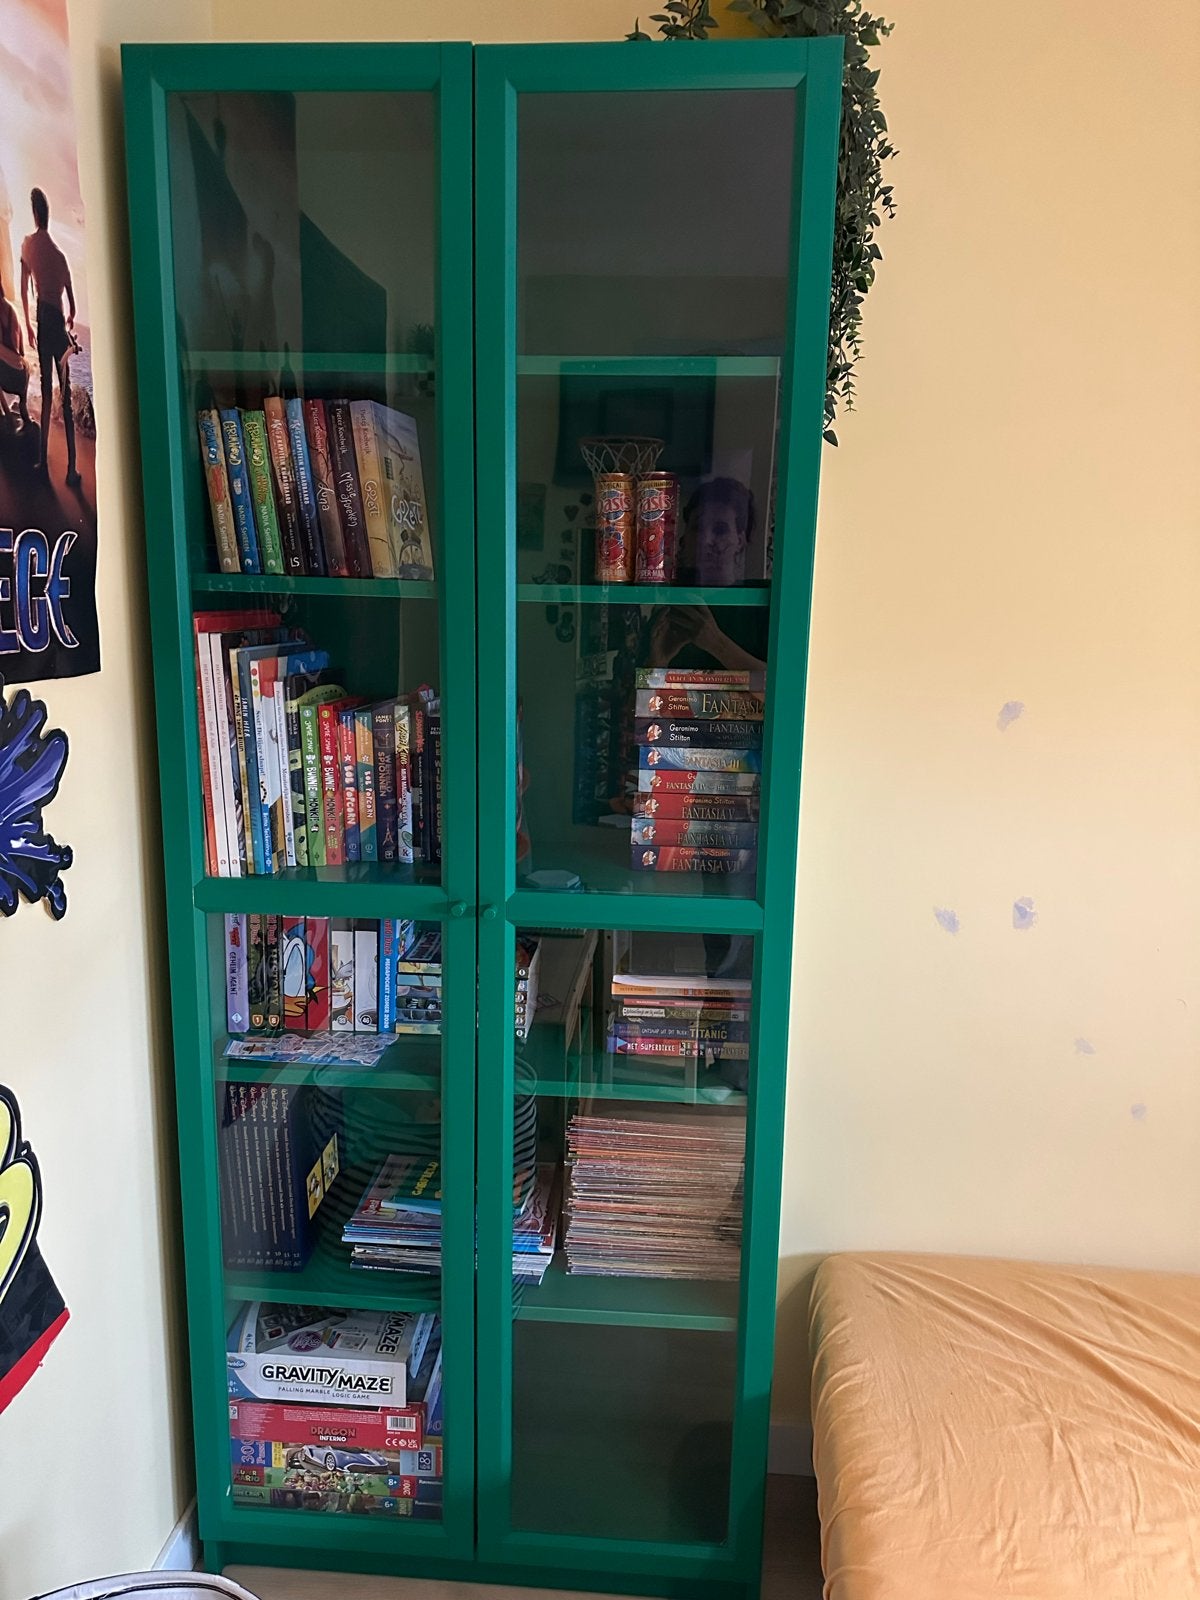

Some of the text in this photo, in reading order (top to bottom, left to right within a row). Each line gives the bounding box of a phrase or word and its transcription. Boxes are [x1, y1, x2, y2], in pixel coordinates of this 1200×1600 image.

[311, 407, 325, 453] Pieter Koolwijk
[338, 426, 348, 454] Koolwijk
[223, 420, 241, 466] GRIMWOOD
[245, 421, 264, 466] GRIMWOOD
[362, 426, 372, 456] Koolwijk
[339, 472, 357, 498] Missie
[317, 482, 334, 511] Luna
[238, 504, 247, 529] NADIA
[260, 505, 269, 529] NADIA
[217, 504, 228, 552] NADIA SHIREEN
[242, 530, 250, 552] SHIREEN
[264, 530, 274, 554] SHIREEN
[670, 724, 698, 732] Geronimo
[670, 733, 690, 742] Stilton
[710, 723, 755, 734] FANTASIA
[397, 745, 410, 764] KING
[685, 757, 726, 768] FANTASIA
[306, 767, 318, 791] BUNNIE
[324, 768, 335, 792] BUNNIE
[378, 752, 386, 796] SPIONNEN
[344, 765, 356, 825] BOB POPCORN
[364, 770, 374, 818] BOB POPCORN
[666, 782, 698, 790] FANTASIA
[683, 796, 712, 804] Geronimo
[682, 807, 724, 820] FANTASIA
[678, 833, 724, 846] FANTASIA
[679, 848, 708, 856] Geronimo
[672, 858, 724, 872] FANTASIA
[250, 924, 260, 944] Duck
[268, 925, 276, 945] Duck
[384, 937, 394, 956] Duck
[230, 976, 238, 996] AGENT
[690, 1028, 728, 1040] TITANIC
[378, 1316, 406, 1354] MAZE
[262, 1365, 391, 1392] GRAVITY MAZE
[278, 1386, 304, 1394] FALLING
[310, 1426, 356, 1437] DRAGON
[388, 1478, 398, 1486] 8+
